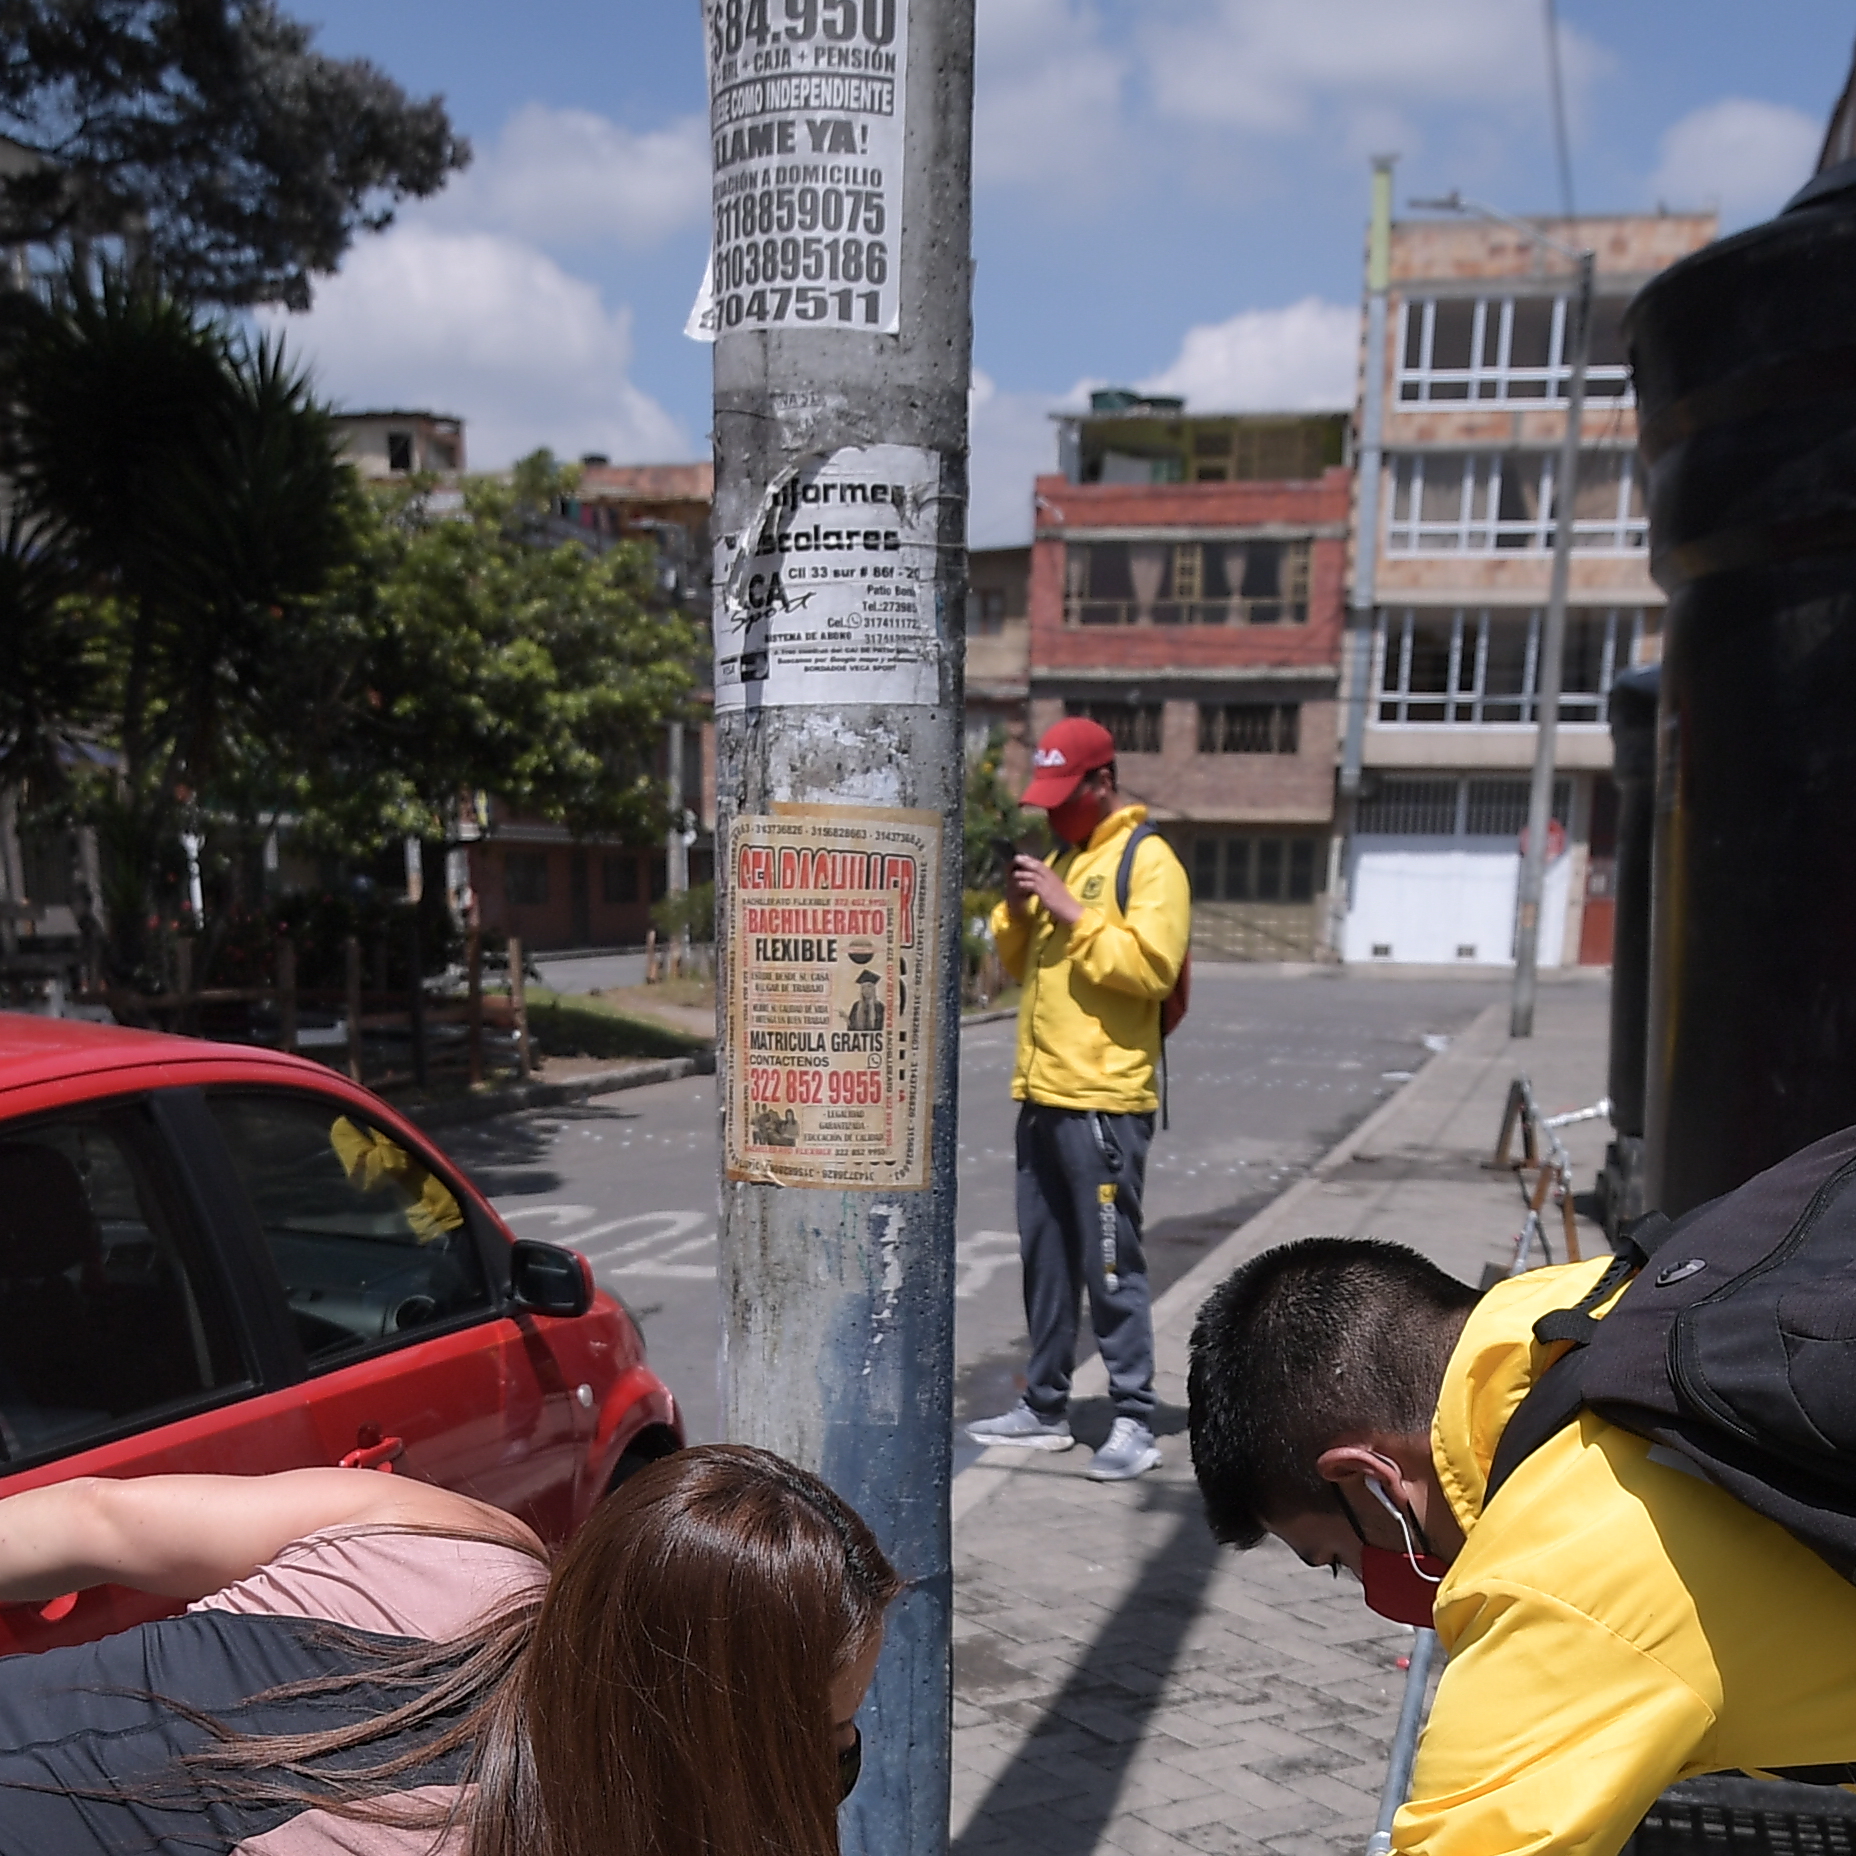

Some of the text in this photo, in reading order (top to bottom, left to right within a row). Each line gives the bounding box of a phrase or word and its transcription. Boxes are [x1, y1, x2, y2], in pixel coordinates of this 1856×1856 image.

[754, 47, 792, 73] CAJA
[814, 45, 896, 74] PENSIÓN
[731, 82, 764, 118] COMO
[765, 74, 893, 115] INDEPENDIENTE
[714, 119, 869, 170] LLAME YA!
[775, 164, 883, 188] DOMICILIO
[811, 567, 829, 580] 33
[833, 568, 856, 580] sur
[867, 584, 892, 597] Patio
[805, 632, 818, 642] DE
[747, 907, 885, 936] BACHILLERATO
[755, 937, 838, 963] FLEXIBLE
[750, 1030, 883, 1053] MATRICULA GRATIS
[750, 1054, 830, 1068] CONTACTENOS
[750, 1068, 883, 1105] 322 852 9955
